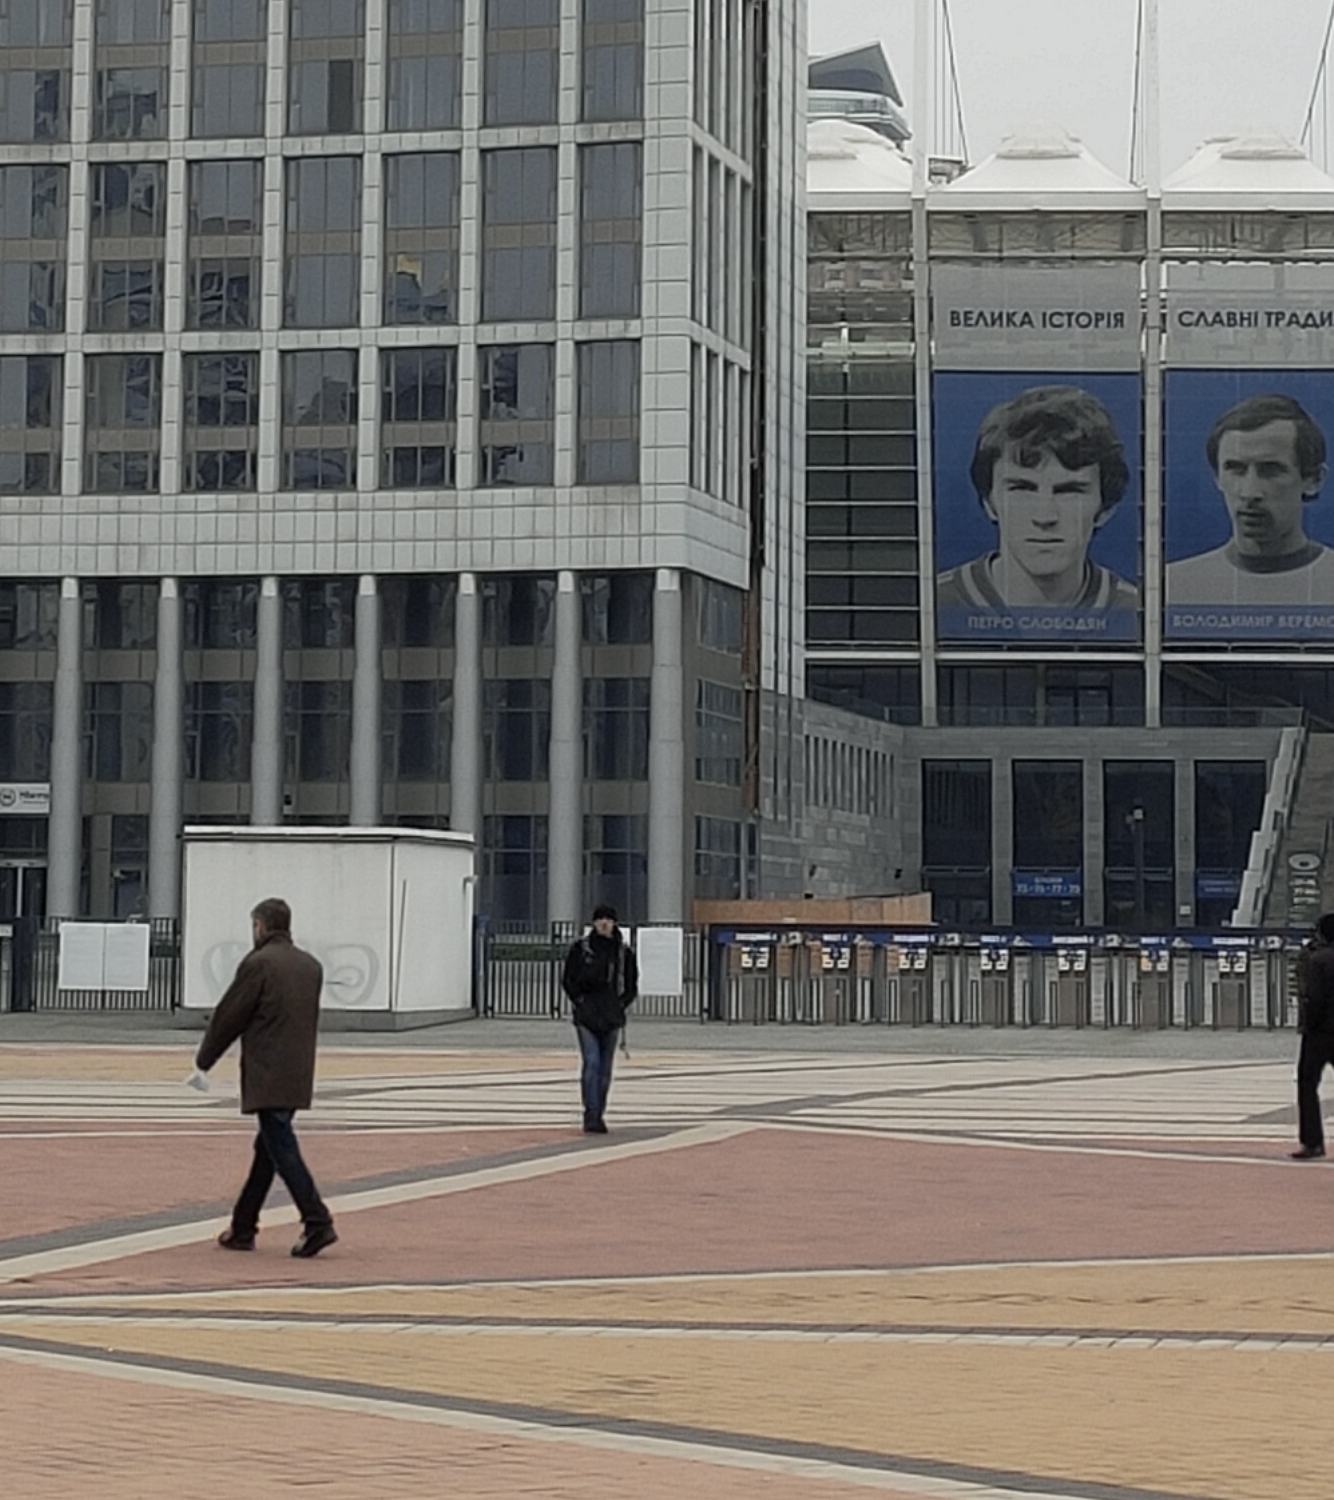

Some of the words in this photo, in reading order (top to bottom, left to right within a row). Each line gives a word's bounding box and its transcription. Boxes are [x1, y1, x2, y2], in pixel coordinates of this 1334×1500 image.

[950, 310, 1035, 328] ВЕЛИКА
[1042, 311, 1125, 329] ІСТОРІЯ
[1178, 310, 1259, 328] СЛАВНІ
[968, 616, 1014, 630] ПЕТРО
[1019, 616, 1108, 631] СЛОБОДЯН
[1172, 615, 1275, 628] ВОЛОДИМИР
